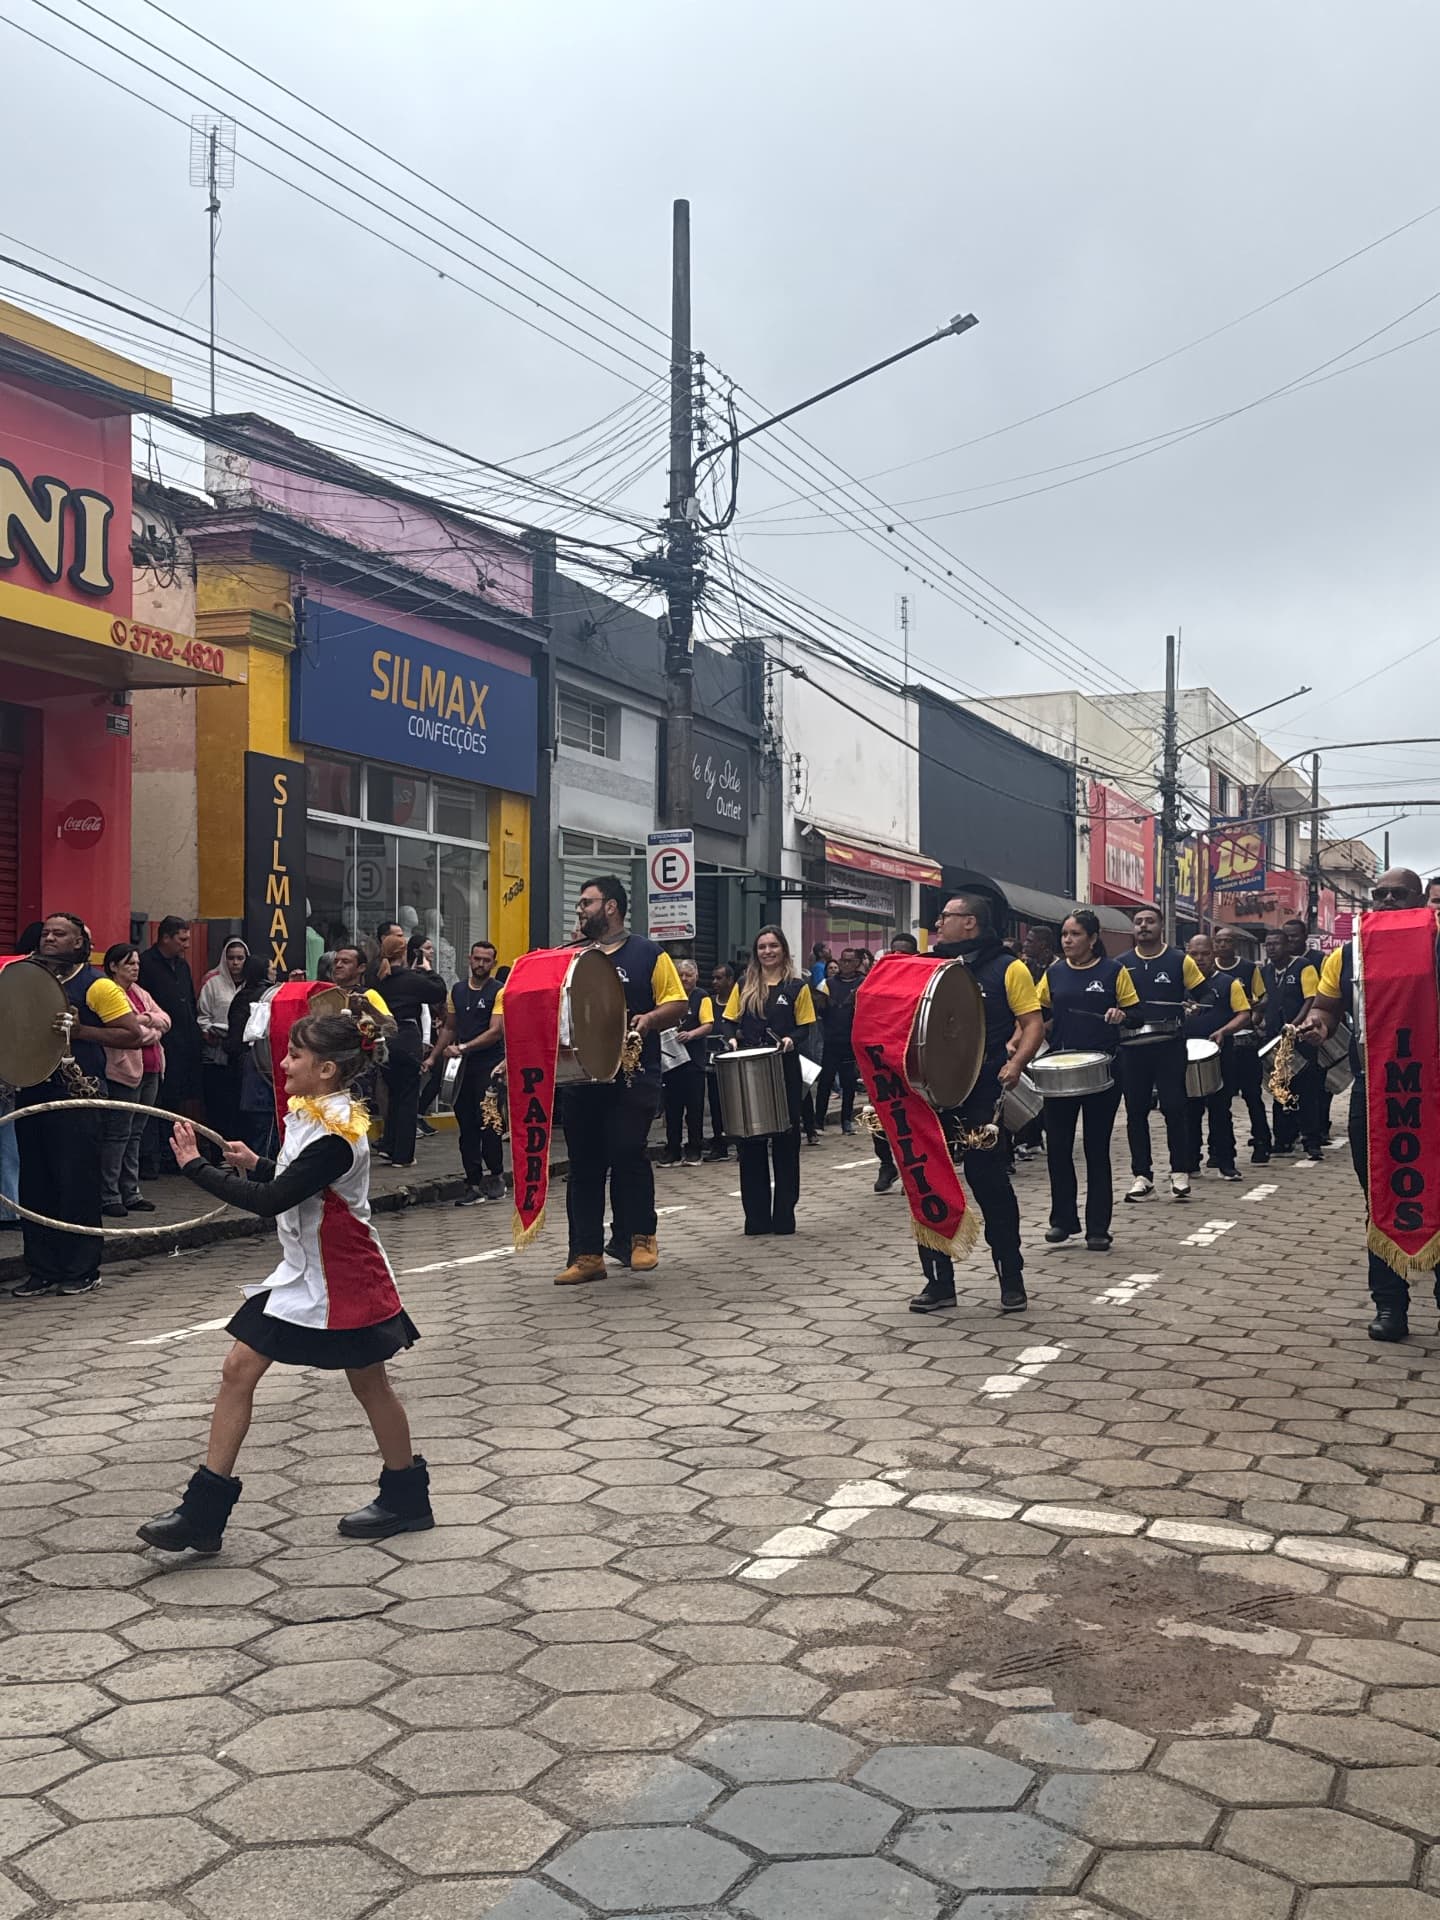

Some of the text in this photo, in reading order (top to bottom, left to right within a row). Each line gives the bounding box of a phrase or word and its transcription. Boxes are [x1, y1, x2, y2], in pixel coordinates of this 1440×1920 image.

[129, 624, 224, 675] 3732-4820
[370, 650, 489, 730] SILMAX
[407, 715, 487, 755] CONFECÇÕES
[704, 756, 717, 800] by
[716, 796, 742, 821] Outlet
[265, 774, 290, 973] SILMAX
[662, 855, 678, 884] E
[520, 1067, 547, 1211] PADRE
[1384, 1028, 1425, 1231] IMMOOS
